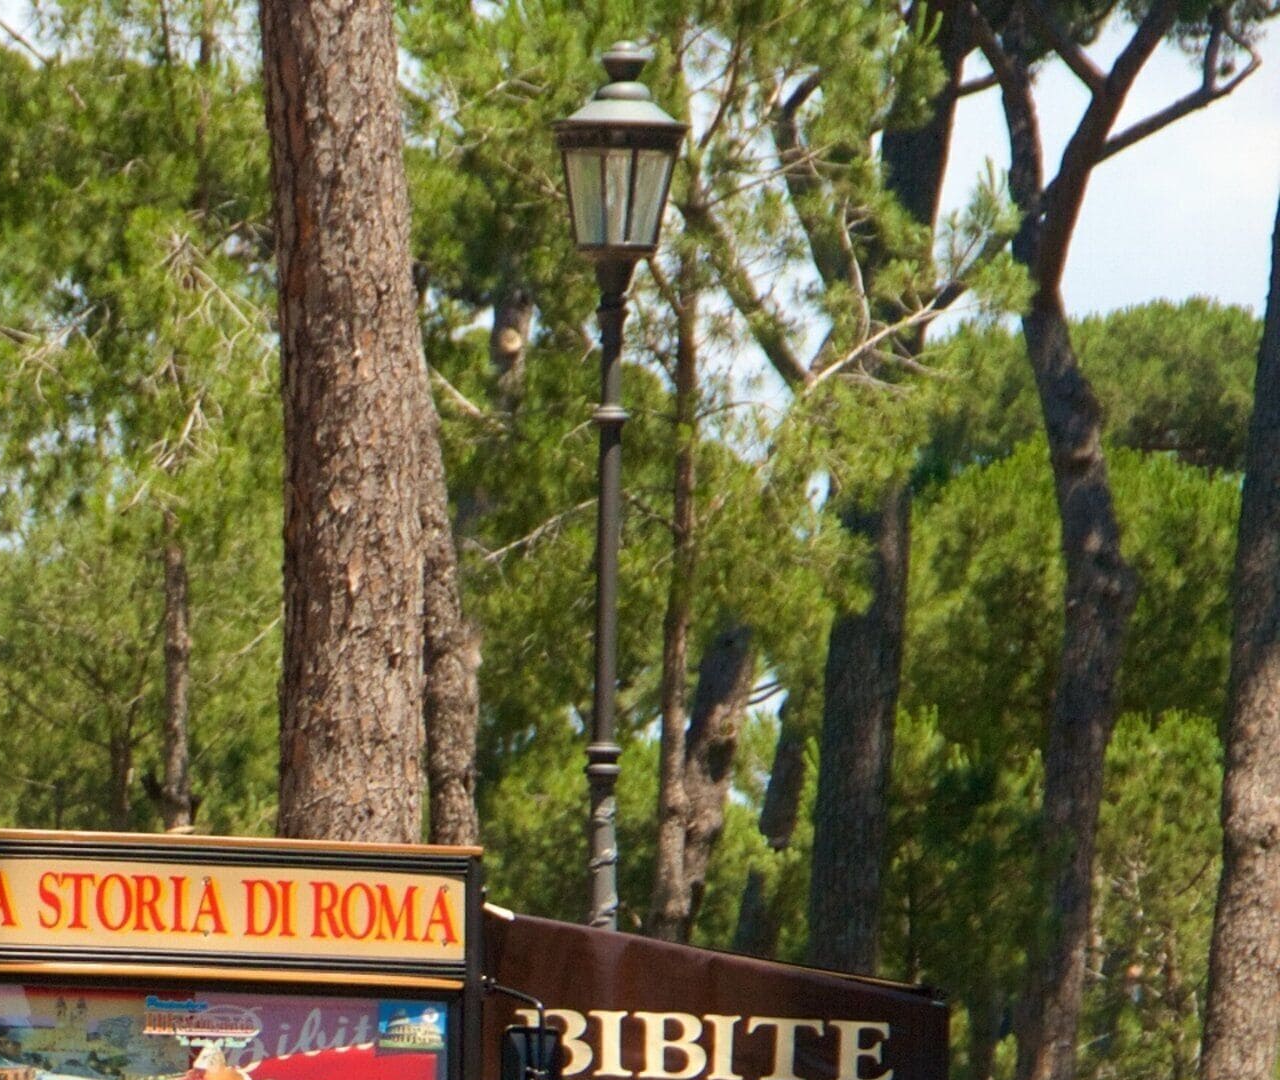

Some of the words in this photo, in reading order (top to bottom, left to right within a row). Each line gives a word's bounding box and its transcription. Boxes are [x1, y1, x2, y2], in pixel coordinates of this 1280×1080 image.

[37, 870, 230, 934] STORIA
[243, 879, 298, 938] DI
[310, 881, 460, 944] ROMA
